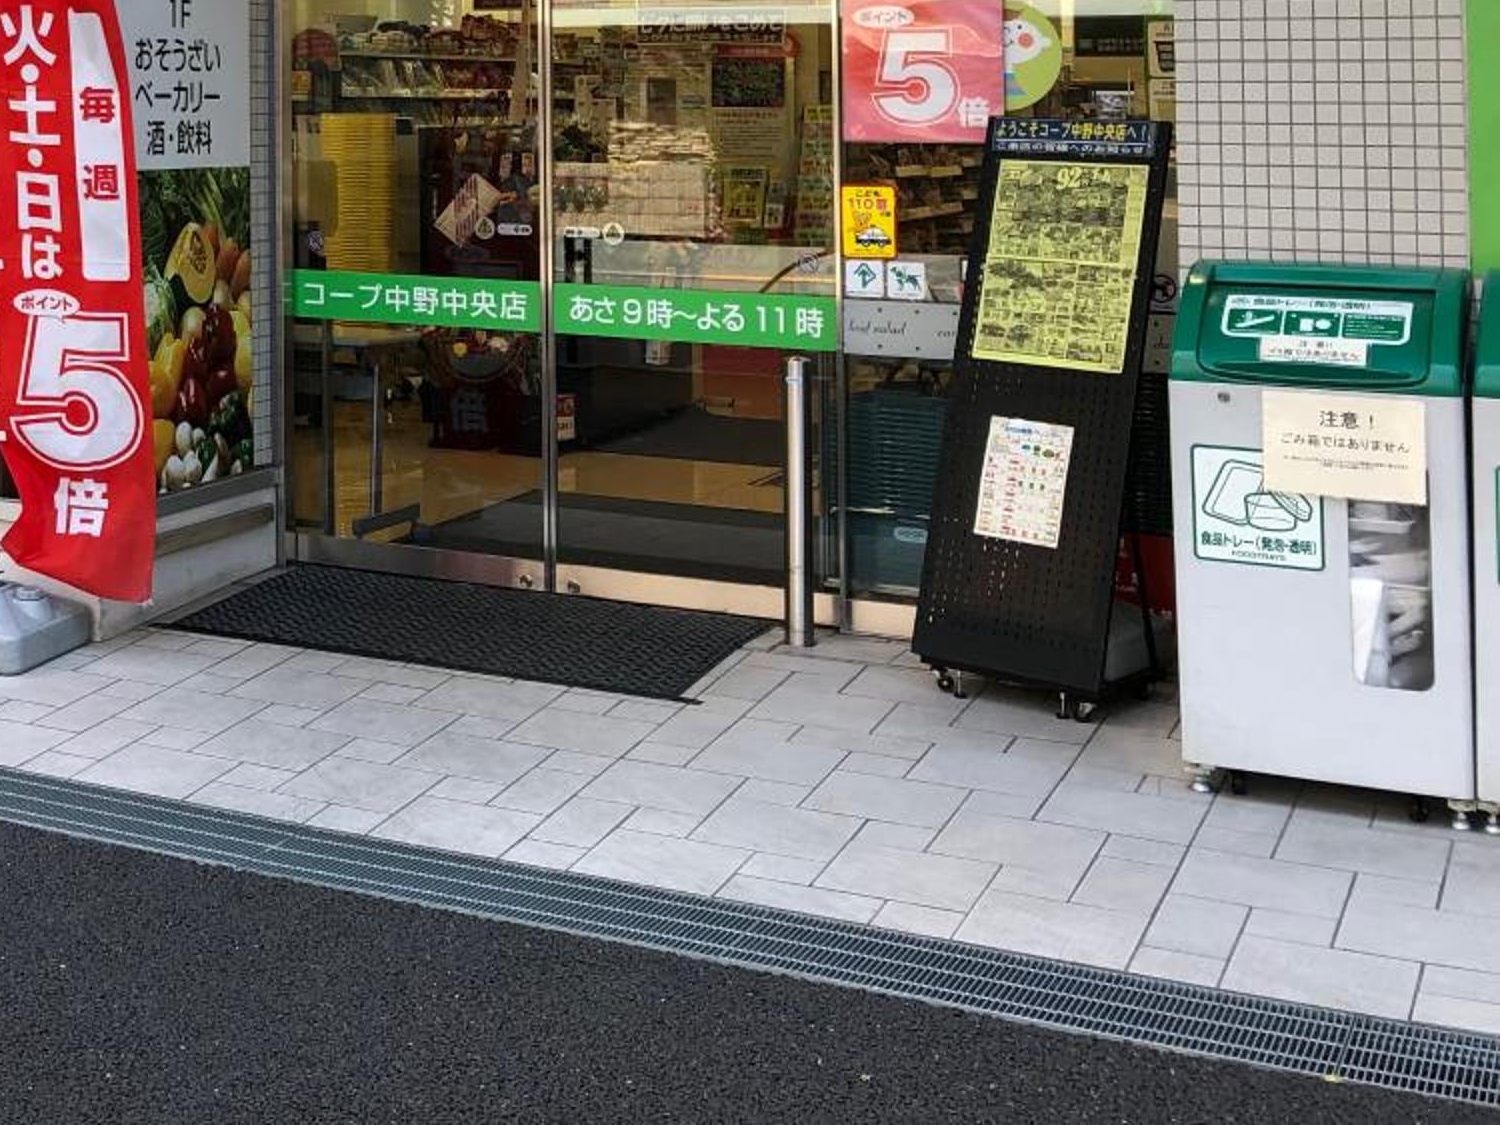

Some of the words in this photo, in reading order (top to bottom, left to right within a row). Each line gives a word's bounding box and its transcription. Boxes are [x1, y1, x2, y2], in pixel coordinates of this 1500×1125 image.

[860, 10, 908, 24] ポイント
[134, 38, 222, 74] おそうざい
[135, 80, 221, 114] ベーカリー
[77, 86, 121, 204] 毎週
[146, 119, 213, 156] 酒・飲料
[19, 292, 73, 313] ポイント
[303, 282, 528, 321] コープ中野中央店
[1281, 432, 1410, 454] ごみ箱ではありません
